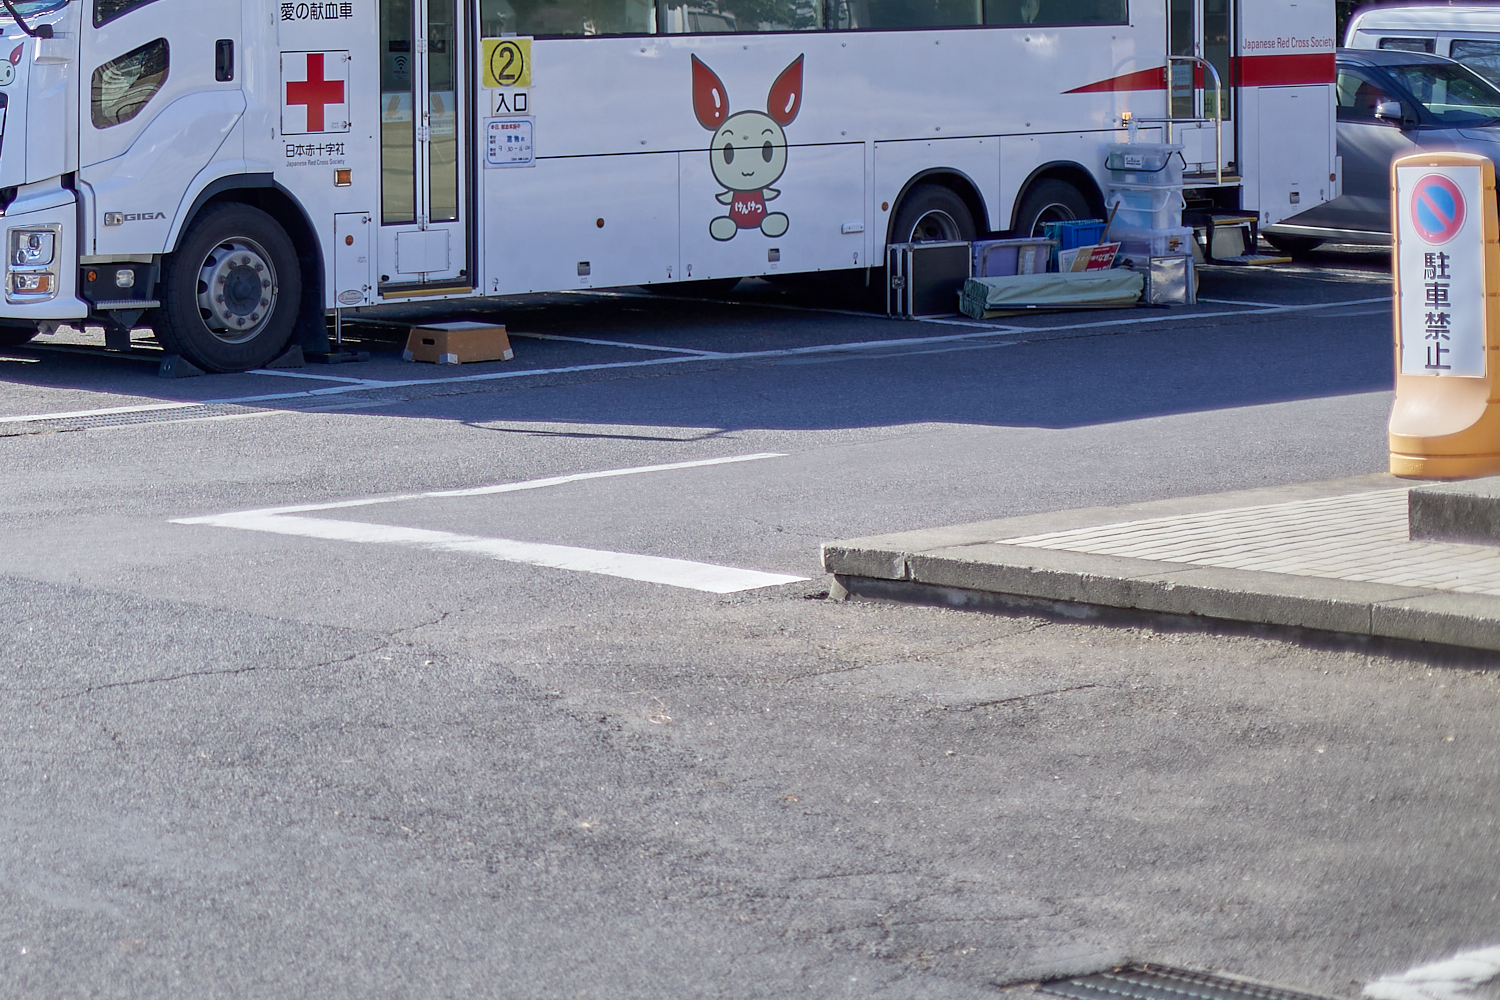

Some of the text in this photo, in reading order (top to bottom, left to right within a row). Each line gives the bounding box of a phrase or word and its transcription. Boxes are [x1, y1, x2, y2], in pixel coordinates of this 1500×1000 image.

[280, 1, 353, 21] 愛の献血車
[1242, 36, 1335, 51] Japanese Red Cross Society
[496, 93, 527, 113] 入口
[286, 142, 345, 157] 日本赤十字社
[734, 200, 763, 215] けんけつ
[123, 211, 166, 222] GIGA
[1424, 251, 1451, 370] 駐車禁止
